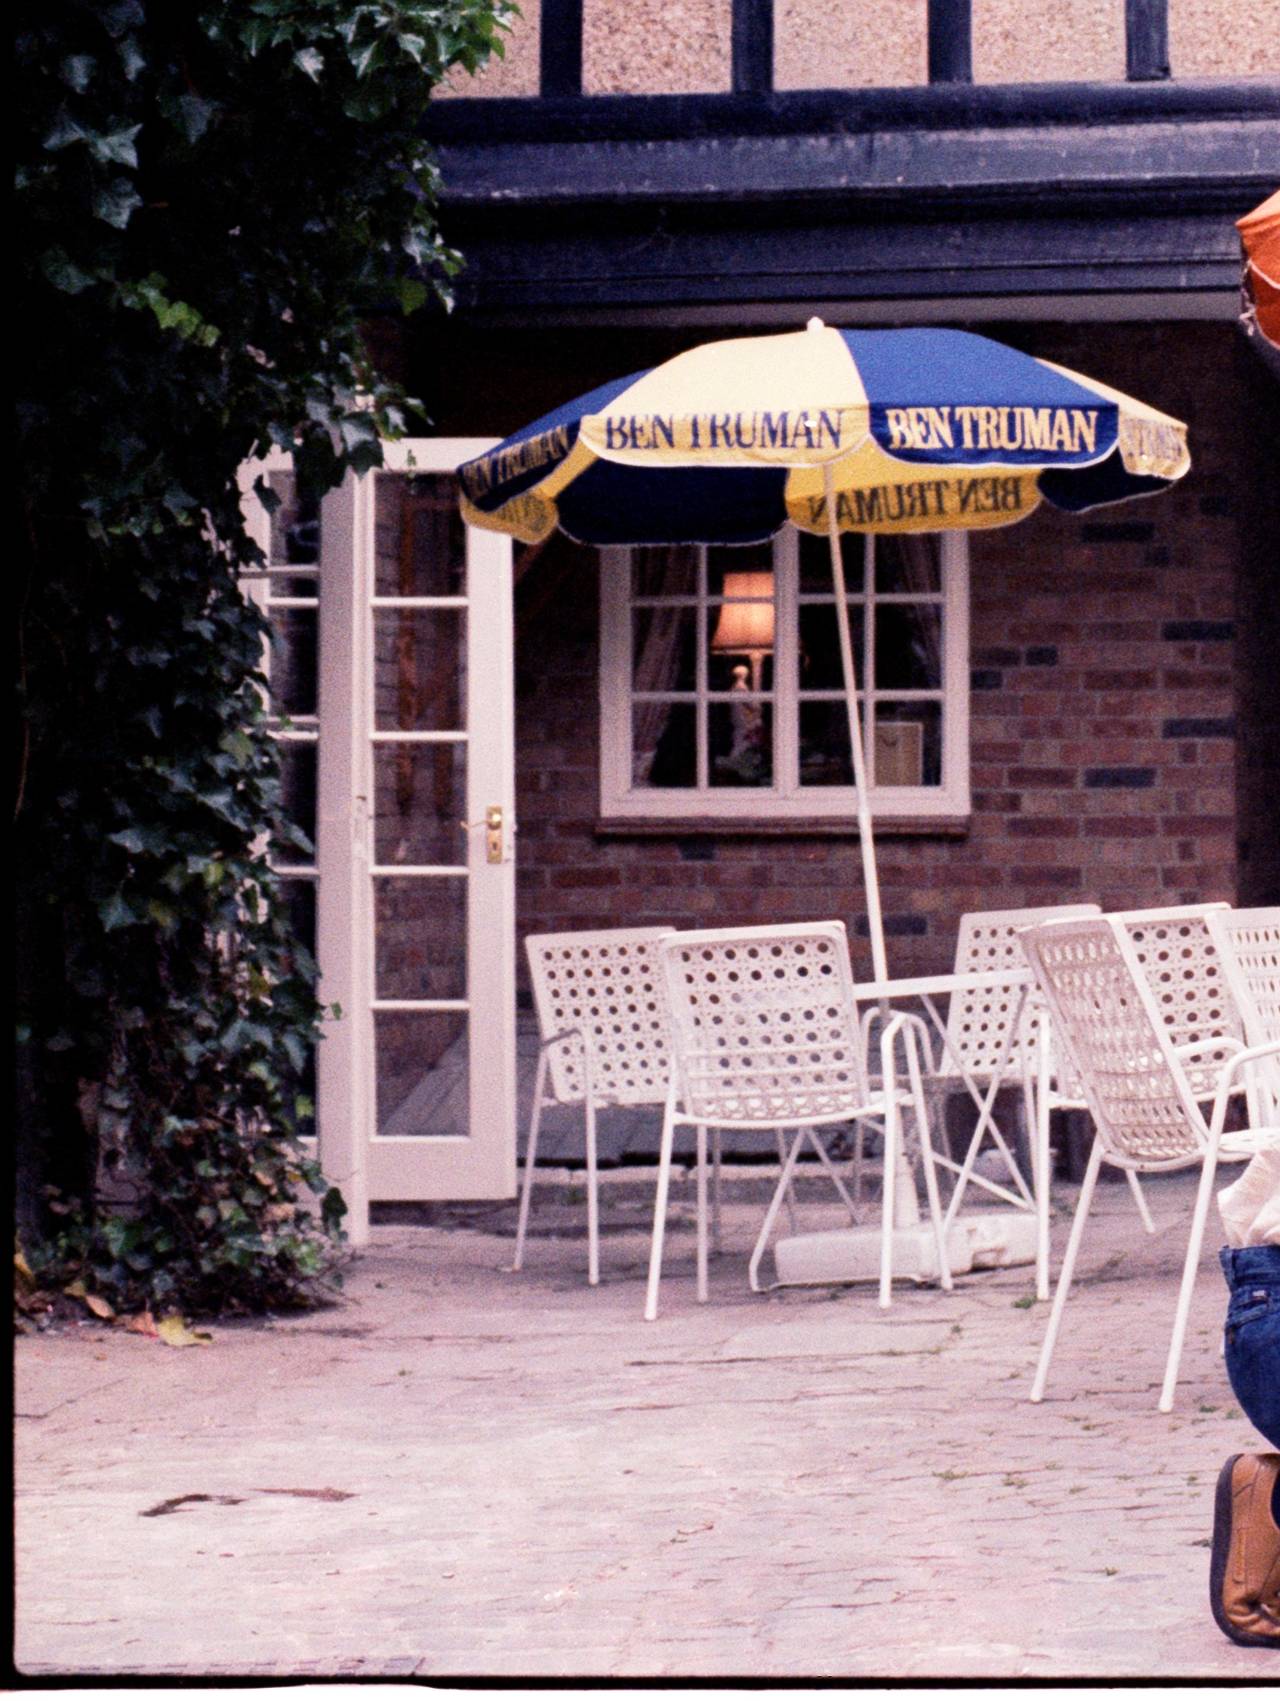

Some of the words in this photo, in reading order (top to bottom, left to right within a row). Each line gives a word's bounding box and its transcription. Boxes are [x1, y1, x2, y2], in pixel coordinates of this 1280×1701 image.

[605, 414, 675, 450] BEN
[688, 409, 845, 450] TRUMAN
[885, 406, 955, 450] BEN
[955, 406, 1098, 453] TRUMAN
